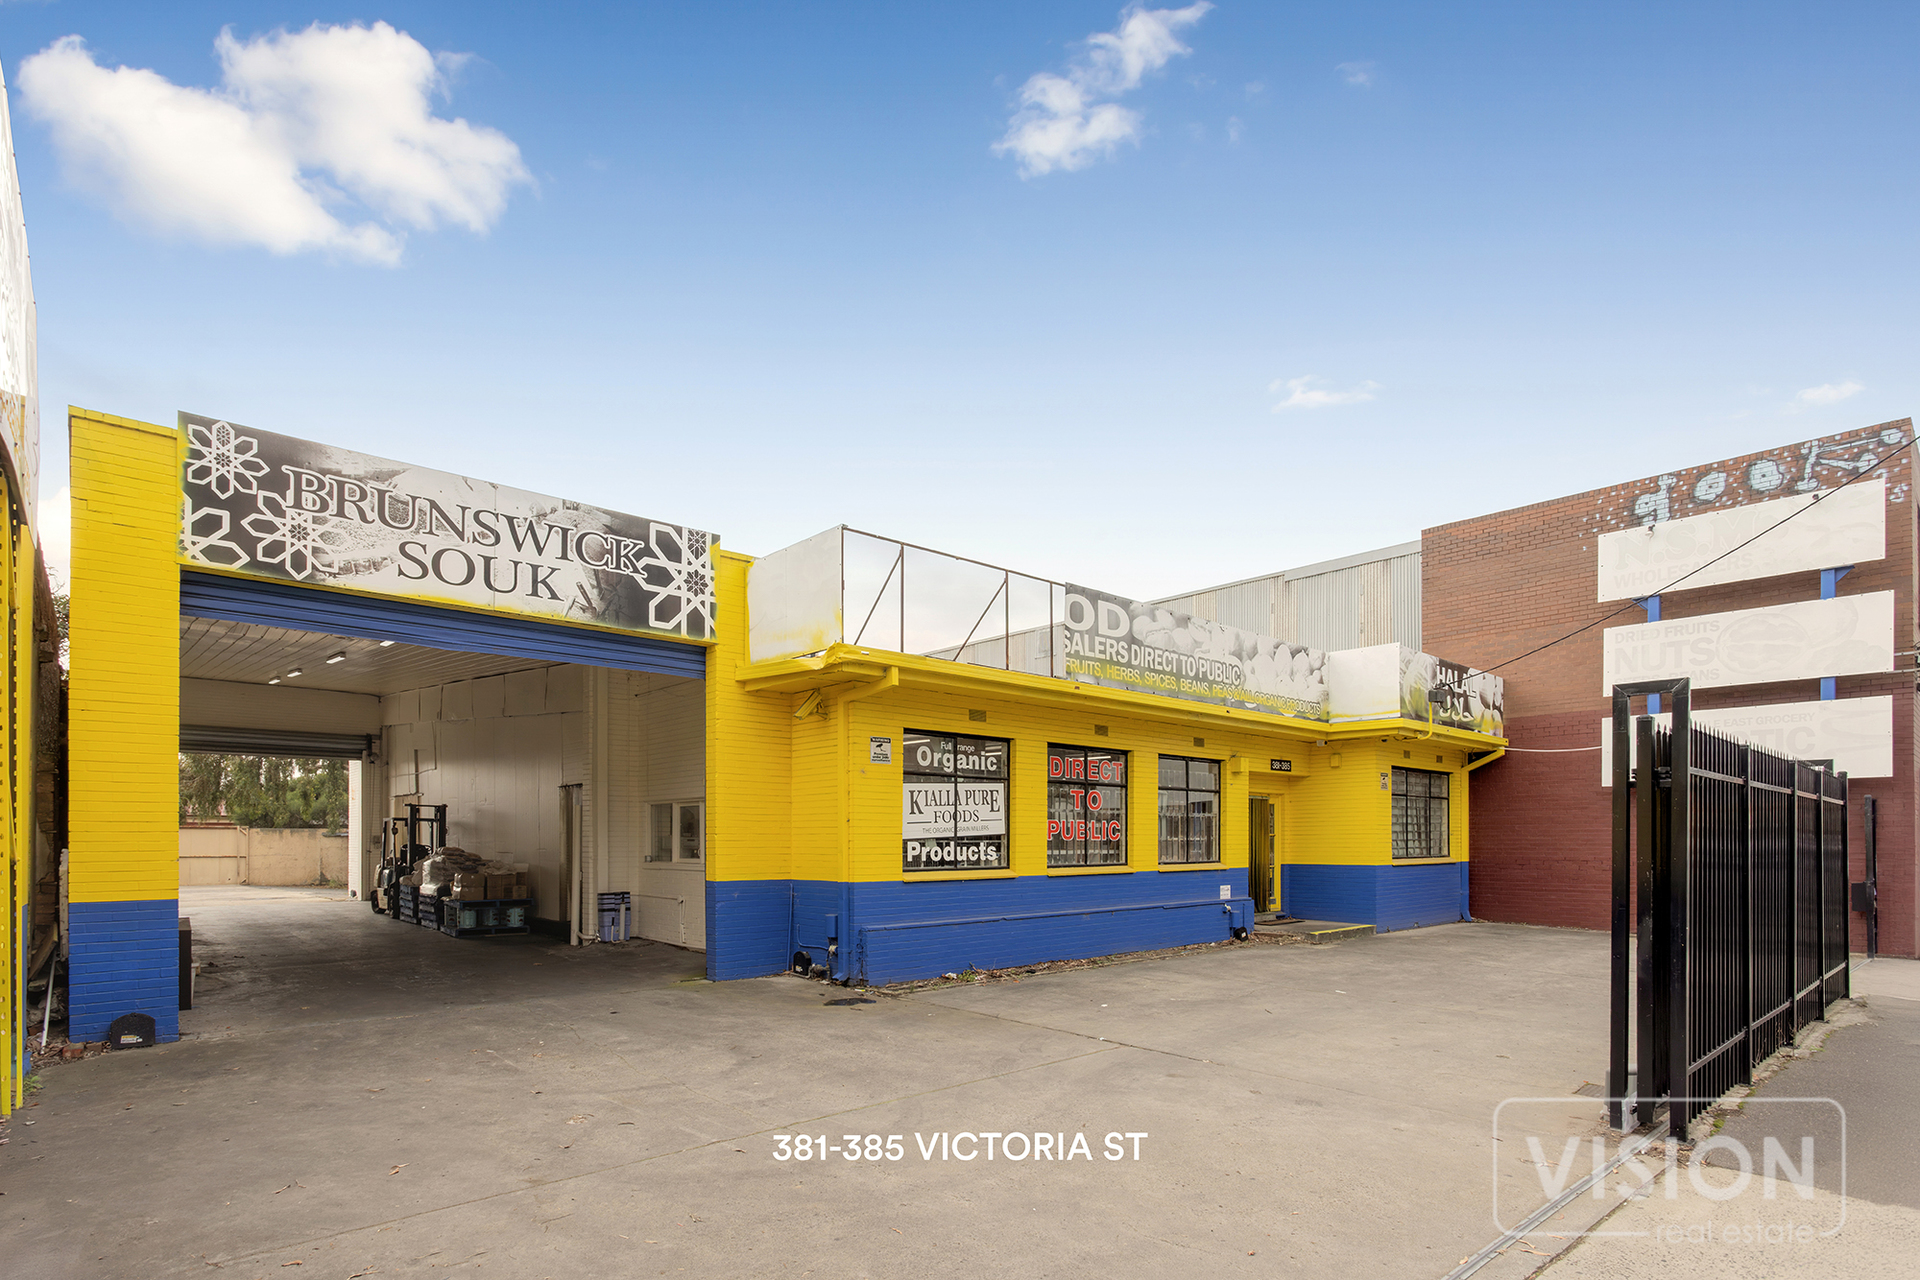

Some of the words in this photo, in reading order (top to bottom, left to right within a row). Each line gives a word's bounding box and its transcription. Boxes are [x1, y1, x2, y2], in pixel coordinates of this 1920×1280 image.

[282, 465, 648, 580] BRUNSWICK
[397, 540, 566, 602] SOUK
[1613, 552, 1755, 590] WHOLESALERS
[1065, 593, 1130, 638] OD
[1614, 627, 1661, 644] DRIED
[1664, 620, 1721, 637] FRUITS
[1131, 644, 1179, 674] DIRECT
[1180, 655, 1197, 678] TO
[1198, 658, 1242, 687] PUBLIC
[1614, 636, 1716, 675] NUTS
[1106, 664, 1142, 686] HERBS,
[1144, 671, 1179, 692] SPICES,
[1436, 665, 1477, 699] HALAL
[1723, 717, 1753, 728] EAST
[1755, 712, 1816, 726] GROCERY
[916, 745, 997, 773] Organic
[1050, 756, 1123, 781] DIRECT
[908, 789, 962, 815] KIALLA
[964, 789, 1001, 813] PURE
[1070, 789, 1103, 811] TO
[933, 809, 980, 824] FOODS
[1047, 819, 1121, 841] PUBLIC
[907, 841, 998, 862] Products
